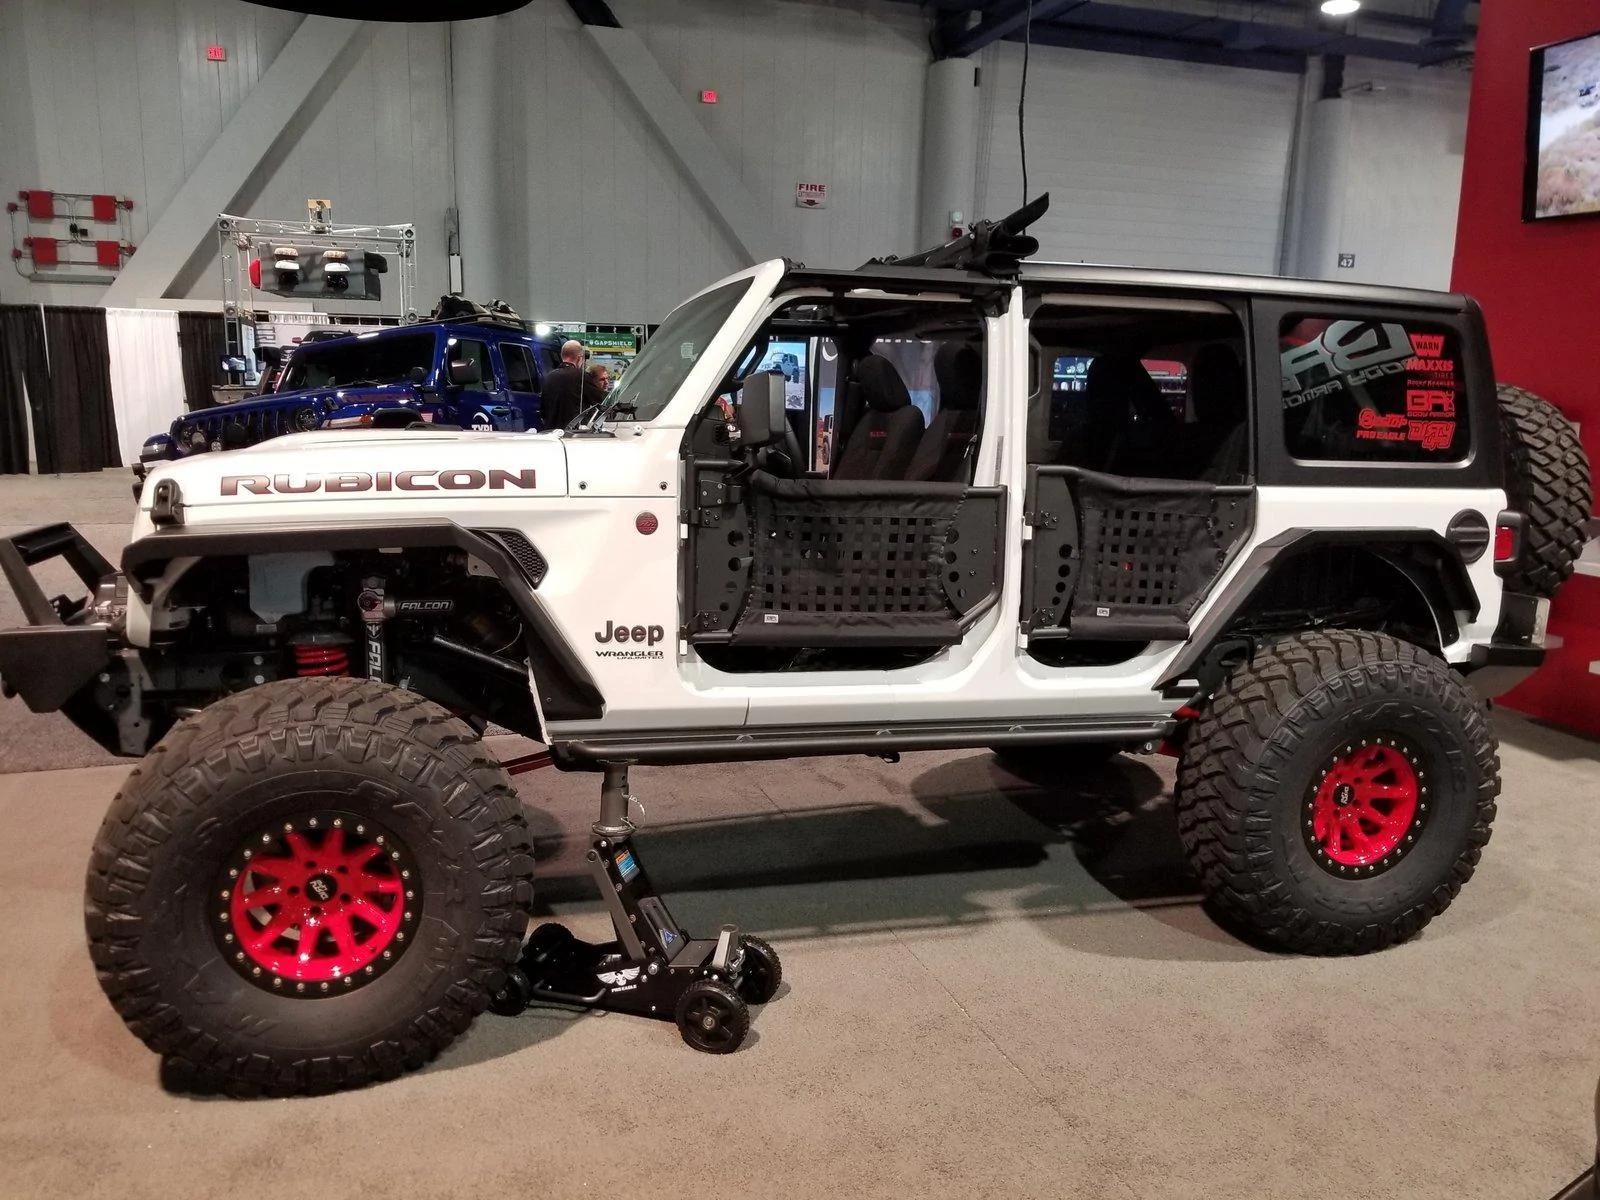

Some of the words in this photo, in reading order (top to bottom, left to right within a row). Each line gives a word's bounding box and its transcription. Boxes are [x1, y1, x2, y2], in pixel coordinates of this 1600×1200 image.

[798, 183, 826, 192] FIRE
[1341, 258, 1352, 267] 47
[1415, 342, 1439, 350] WARN
[1406, 359, 1454, 371] MAXXIS
[220, 469, 537, 496] RUBICON
[401, 601, 449, 610] FALCON
[594, 620, 665, 646] Jeep
